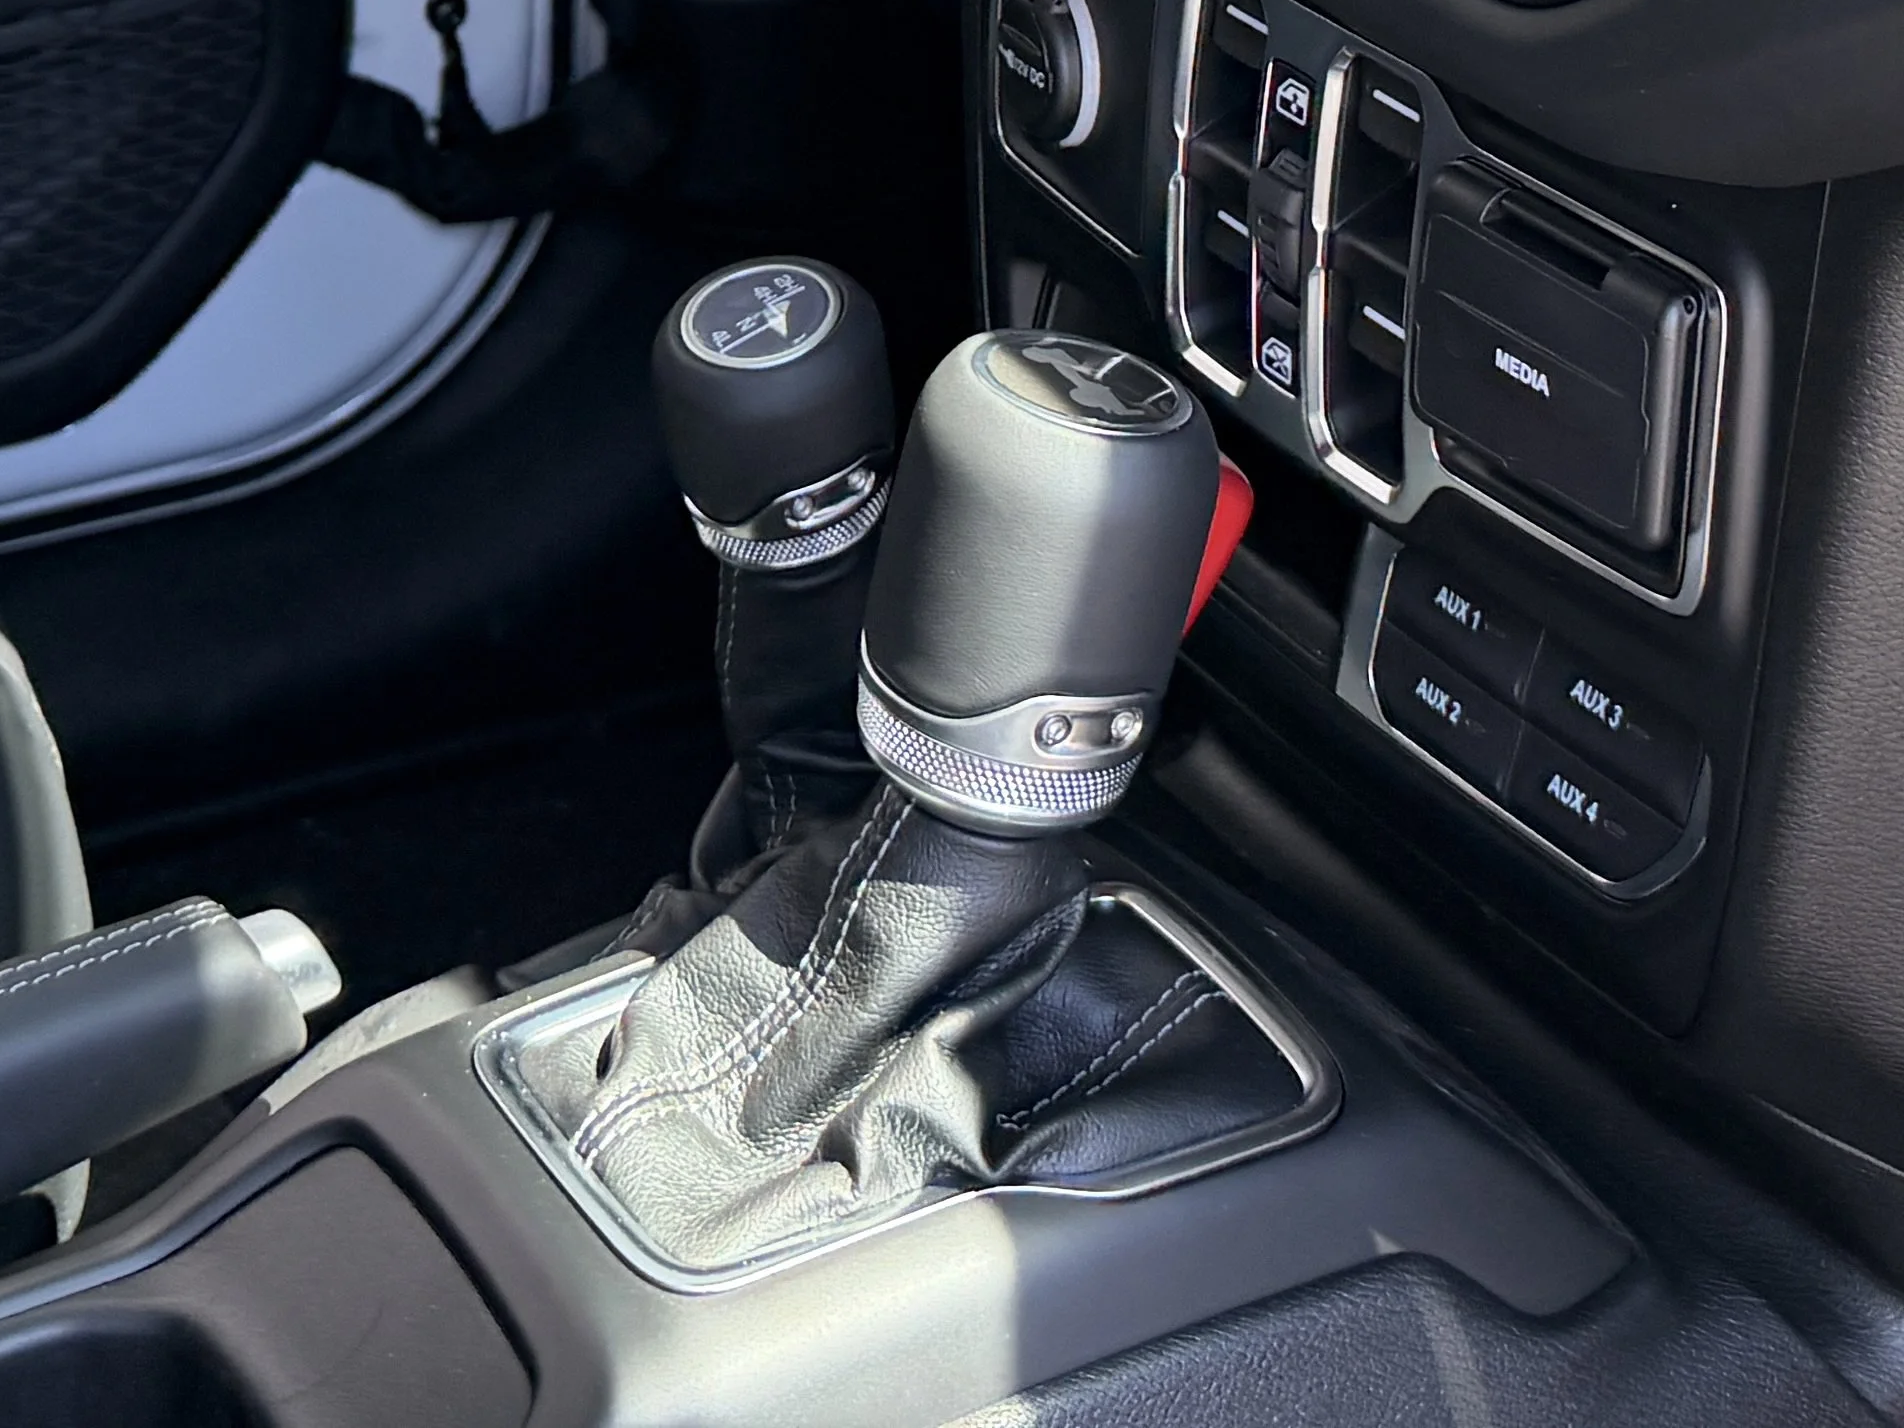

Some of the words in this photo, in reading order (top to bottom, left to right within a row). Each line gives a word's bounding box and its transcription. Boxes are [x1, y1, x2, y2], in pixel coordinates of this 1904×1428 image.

[1029, 66, 1046, 89] DC
[1495, 347, 1551, 398] MEDIA
[1434, 585, 1471, 623] AUX
[1471, 609, 1482, 632] 1
[1415, 676, 1451, 716] AUX
[1449, 699, 1462, 726] 2
[1570, 678, 1609, 723] AUX
[1609, 703, 1624, 731] 3
[1547, 773, 1585, 812] AUX
[1584, 798, 1599, 825] 4
